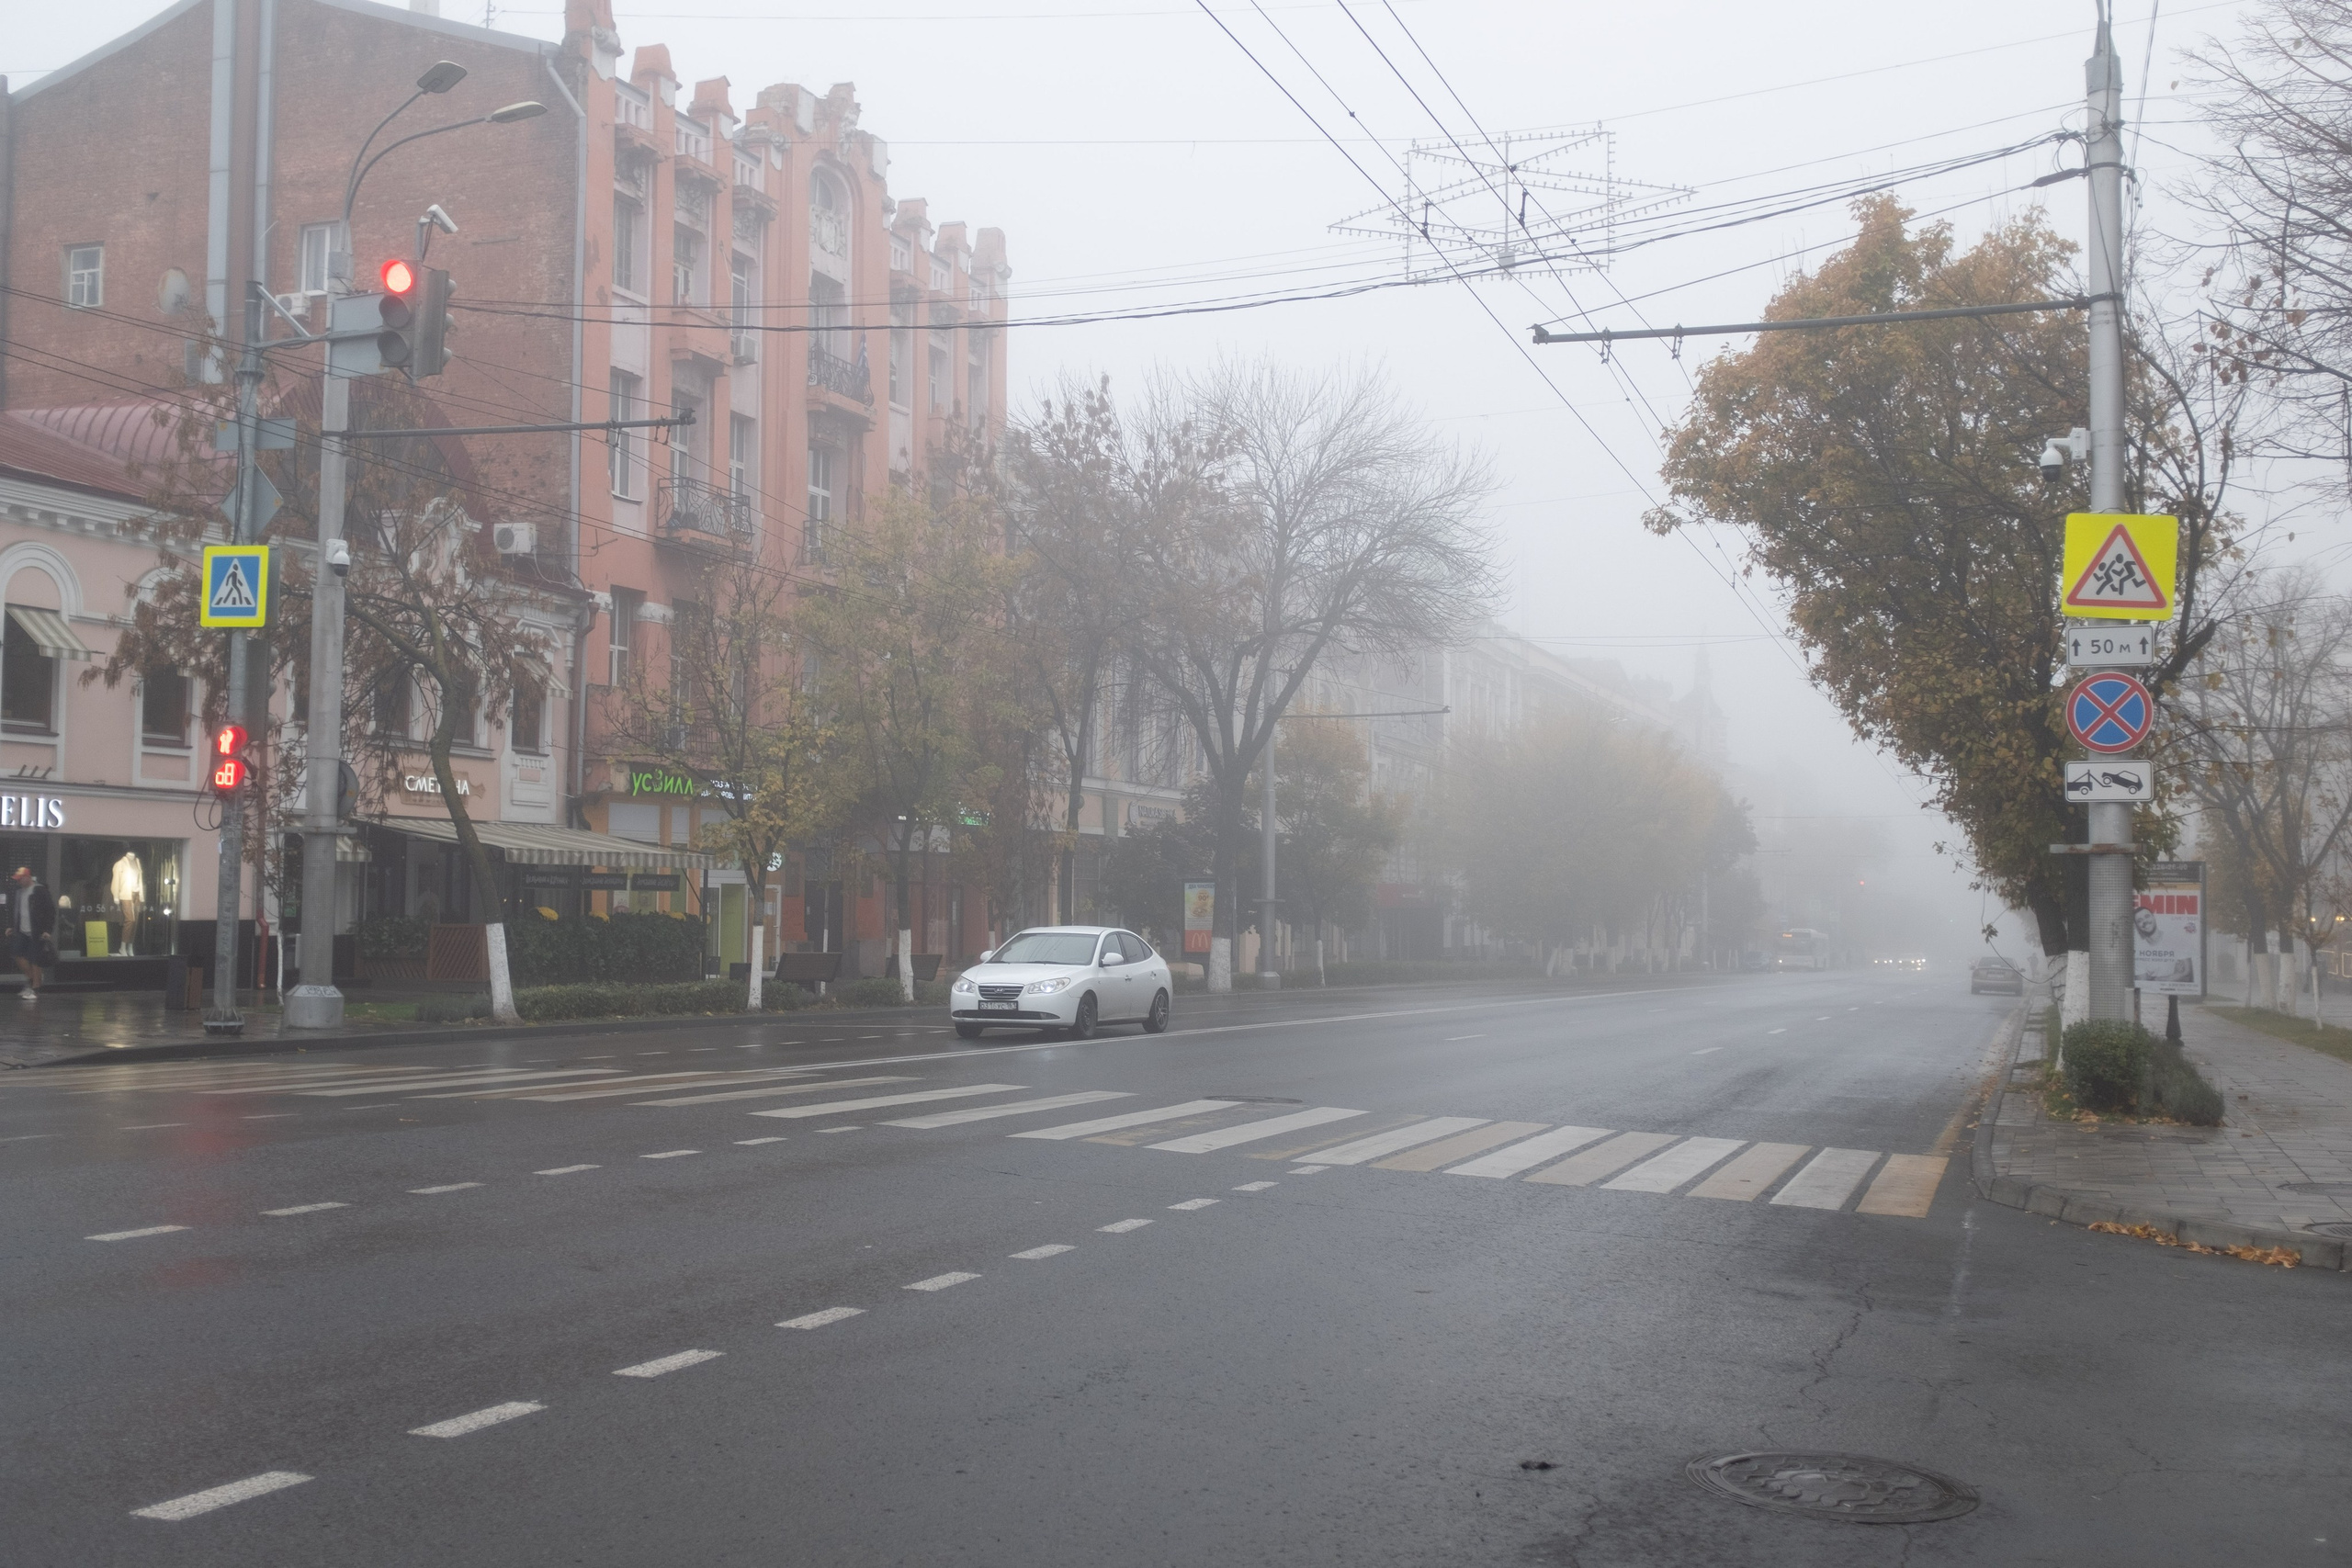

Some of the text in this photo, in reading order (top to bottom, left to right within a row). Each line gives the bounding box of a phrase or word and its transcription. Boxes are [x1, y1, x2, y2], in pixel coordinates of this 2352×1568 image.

[2090, 638, 2114, 654] 50
[405, 775, 469, 795] СМЕТНА
[1, 795, 63, 829] ELIS
